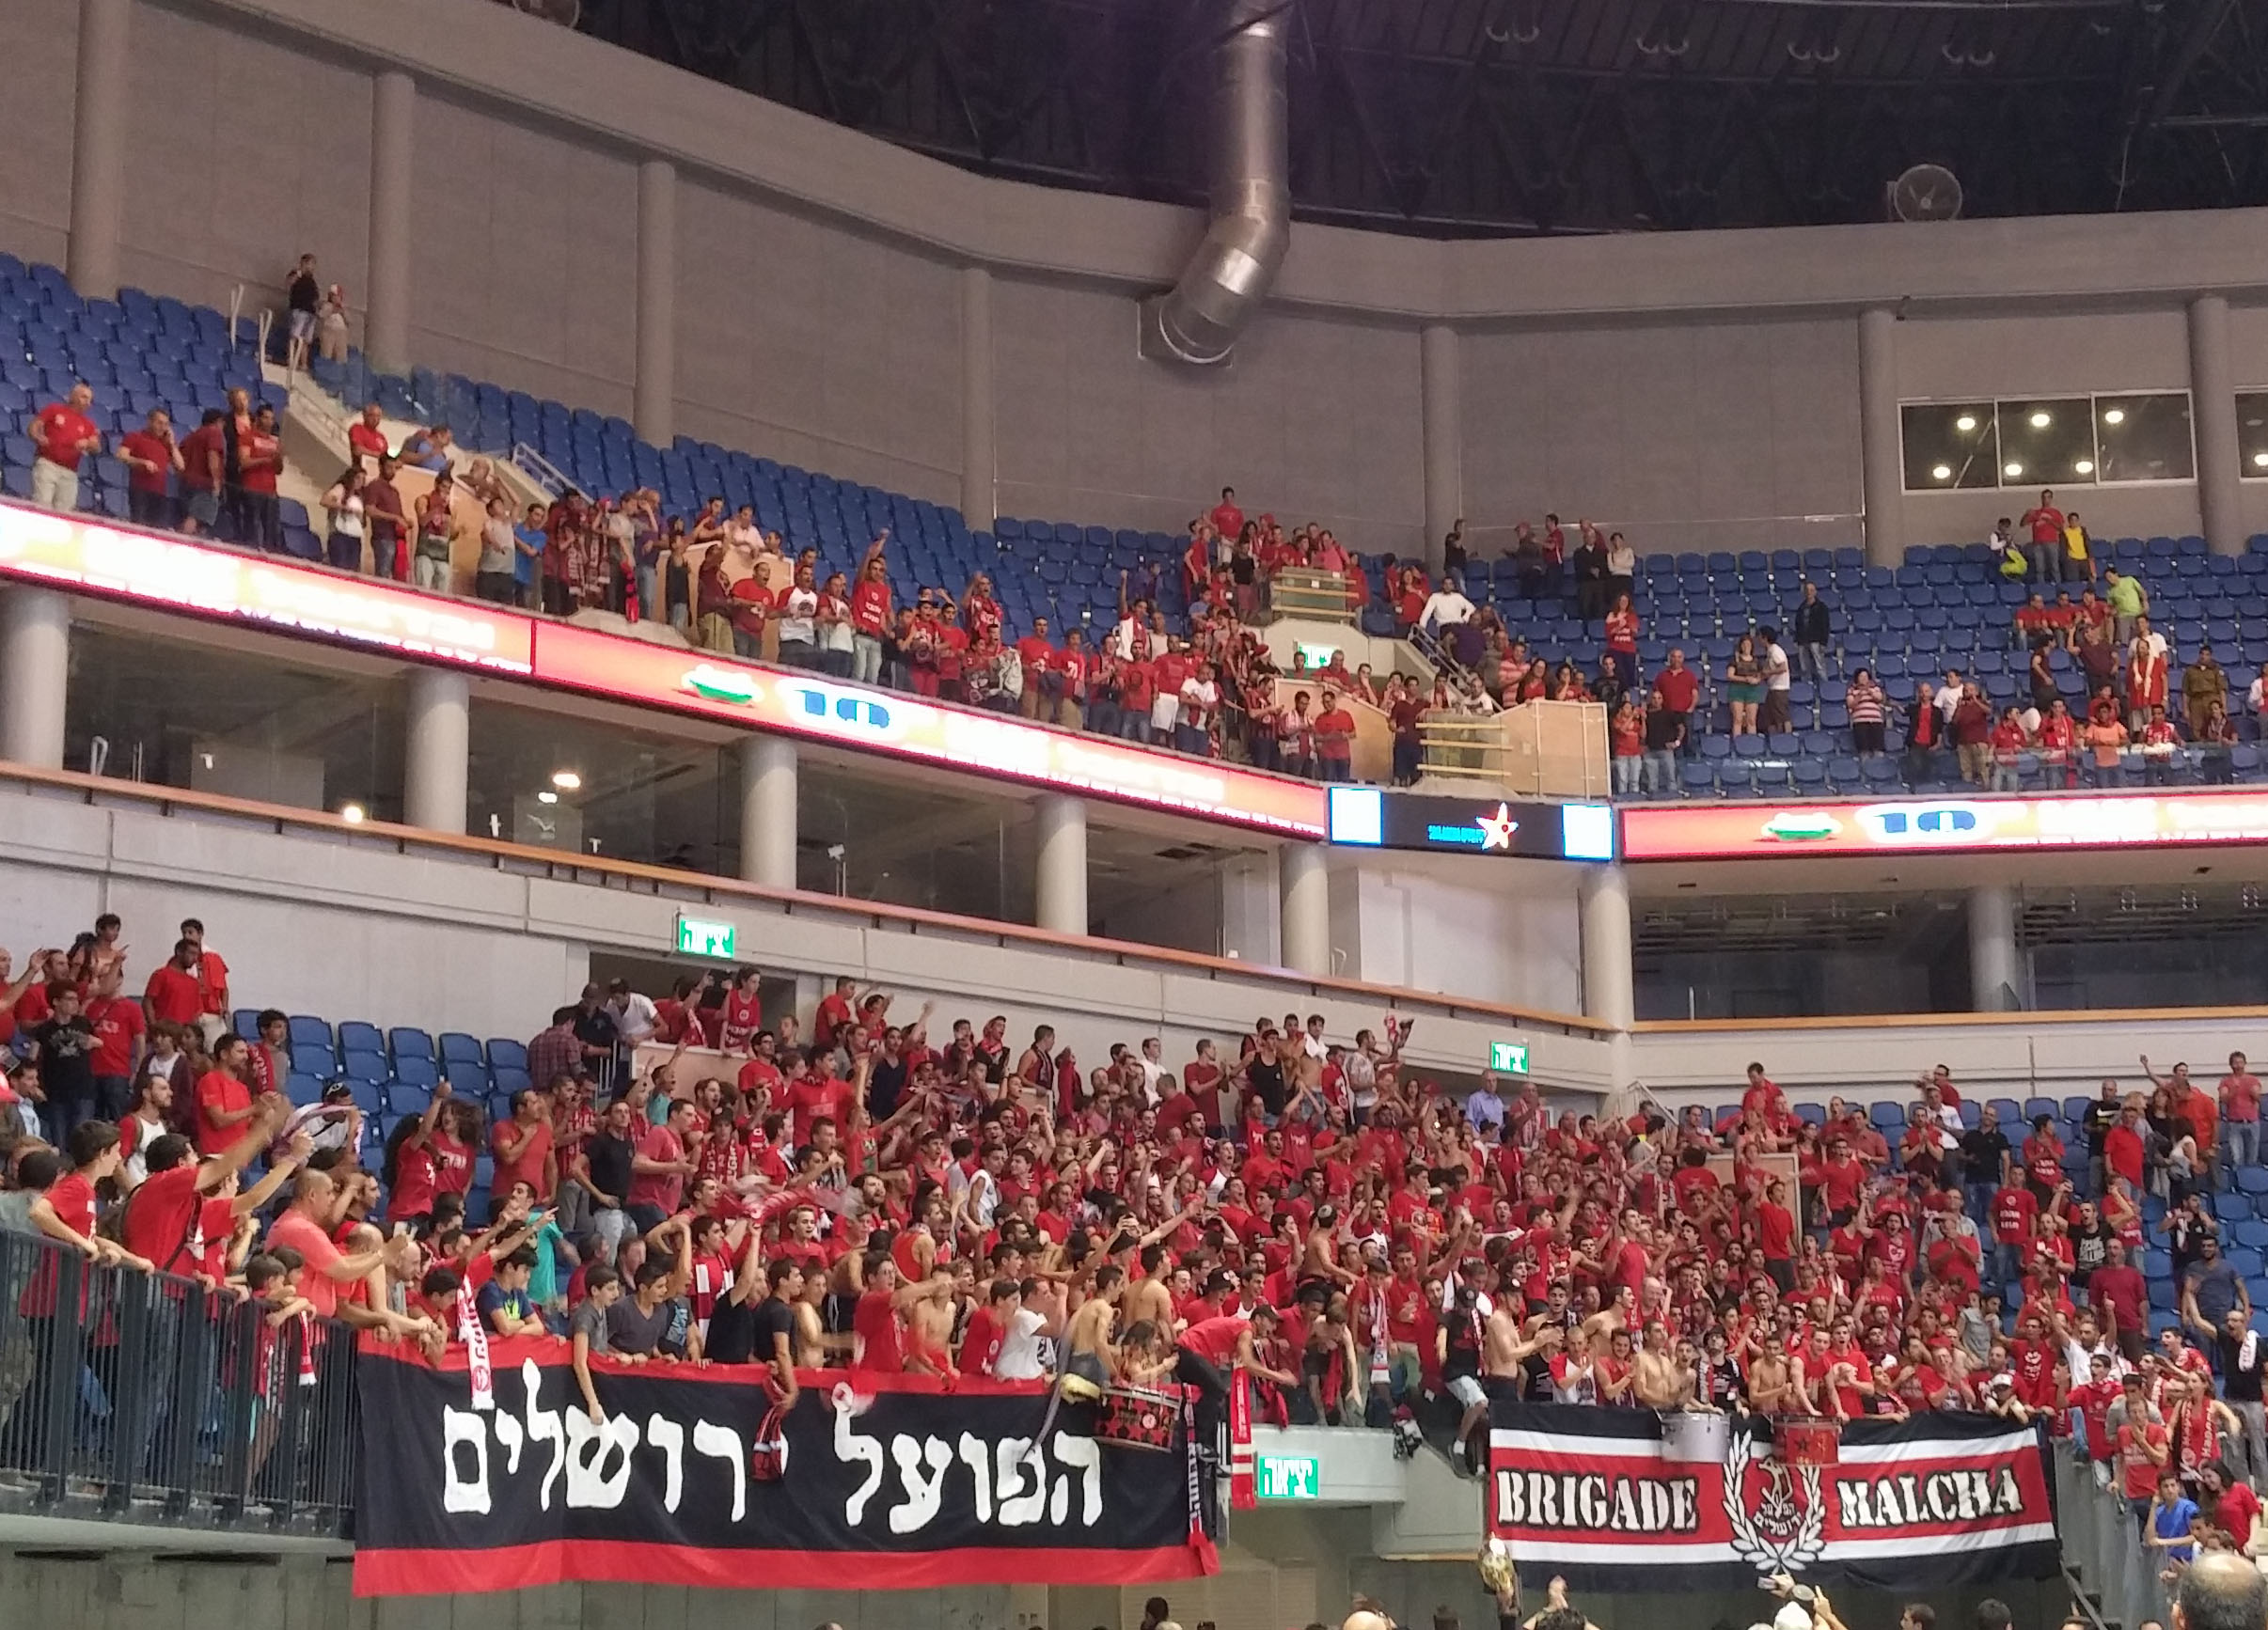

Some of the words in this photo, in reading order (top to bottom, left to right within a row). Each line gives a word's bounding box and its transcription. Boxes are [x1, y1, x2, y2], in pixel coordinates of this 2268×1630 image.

[834, 1387, 1102, 1533] הפועל
[1496, 1469, 1699, 1531] BRIGADE
[1835, 1468, 2023, 1528] MALCHA
